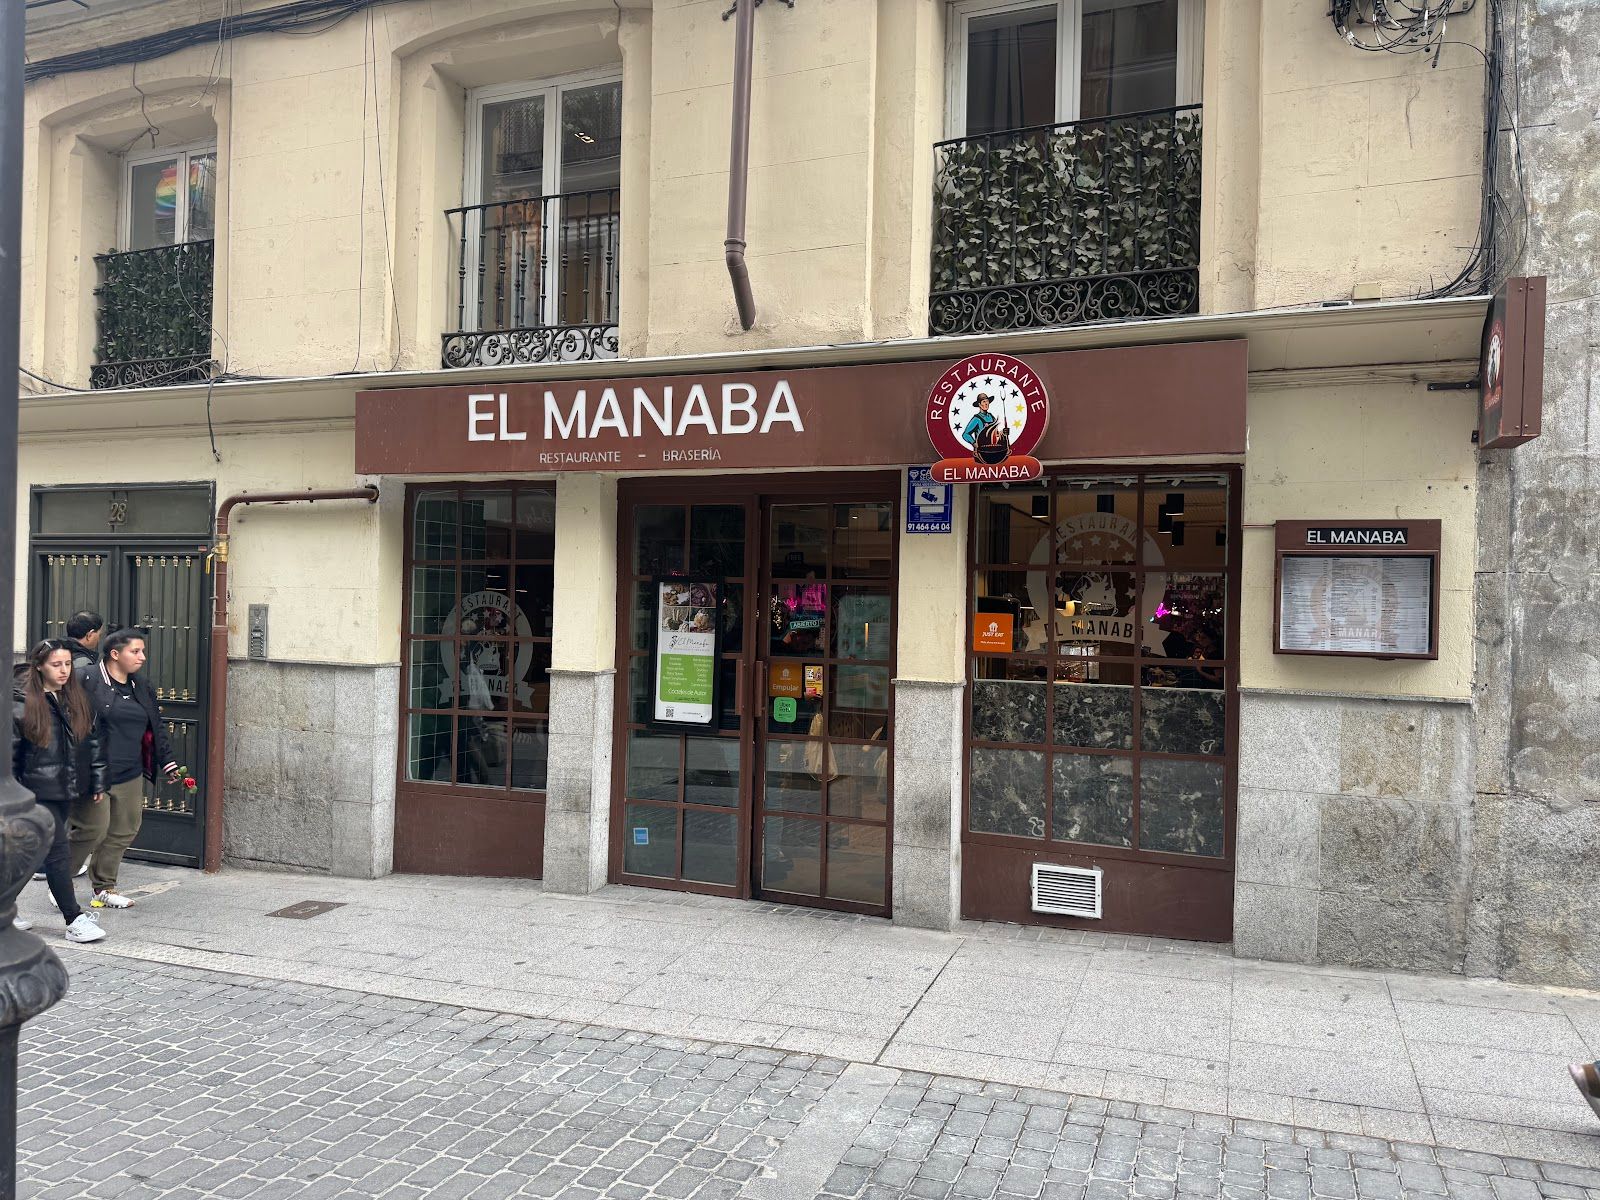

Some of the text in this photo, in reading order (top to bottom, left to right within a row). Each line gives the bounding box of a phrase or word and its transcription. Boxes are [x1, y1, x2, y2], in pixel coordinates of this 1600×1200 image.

[930, 358, 1046, 421] RESTAURANTE
[468, 379, 805, 441] EL MANABA
[539, 450, 621, 465] RESTAURANTE
[662, 446, 722, 462] BRASERÍA
[943, 468, 962, 481] EL
[965, 465, 1030, 480] MANABA
[110, 502, 127, 522] 28
[907, 523, 950, 531] 91 464 64 04
[1306, 530, 1407, 544] EL MANABA
[773, 683, 800, 693] Empujar
